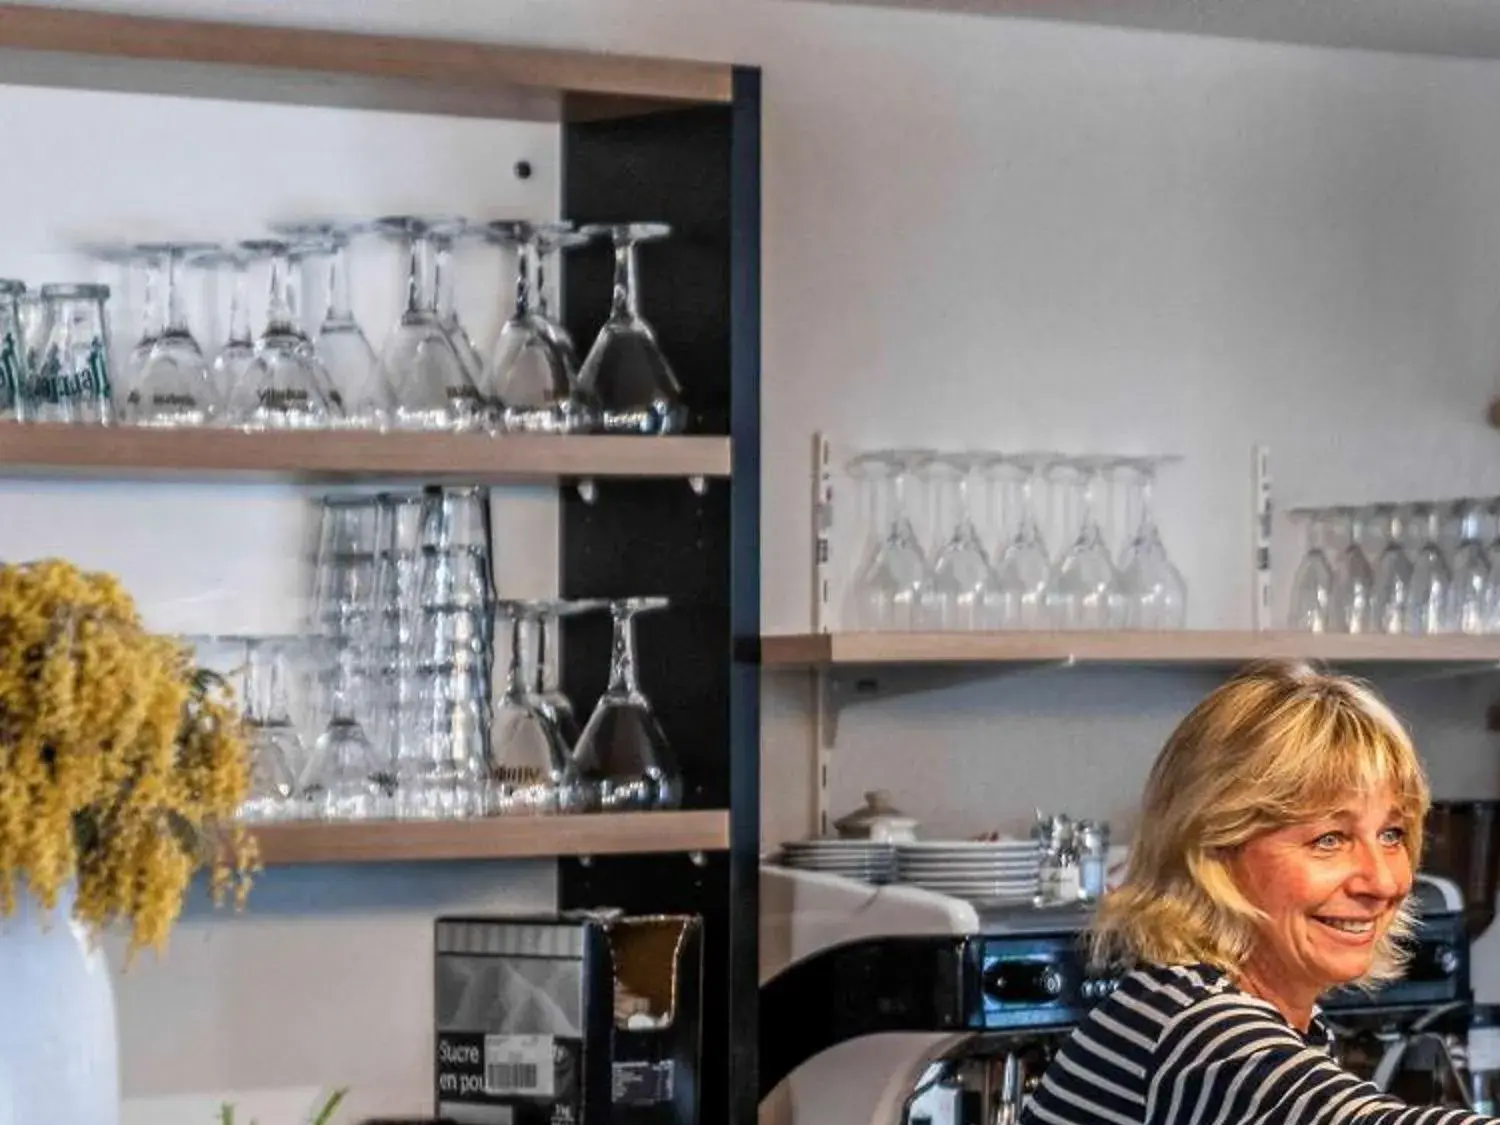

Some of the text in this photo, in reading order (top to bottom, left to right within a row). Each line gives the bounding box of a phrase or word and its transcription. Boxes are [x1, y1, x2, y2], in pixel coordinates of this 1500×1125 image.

[439, 1039, 480, 1064] Sucre
[440, 1073, 489, 1096] en pou
